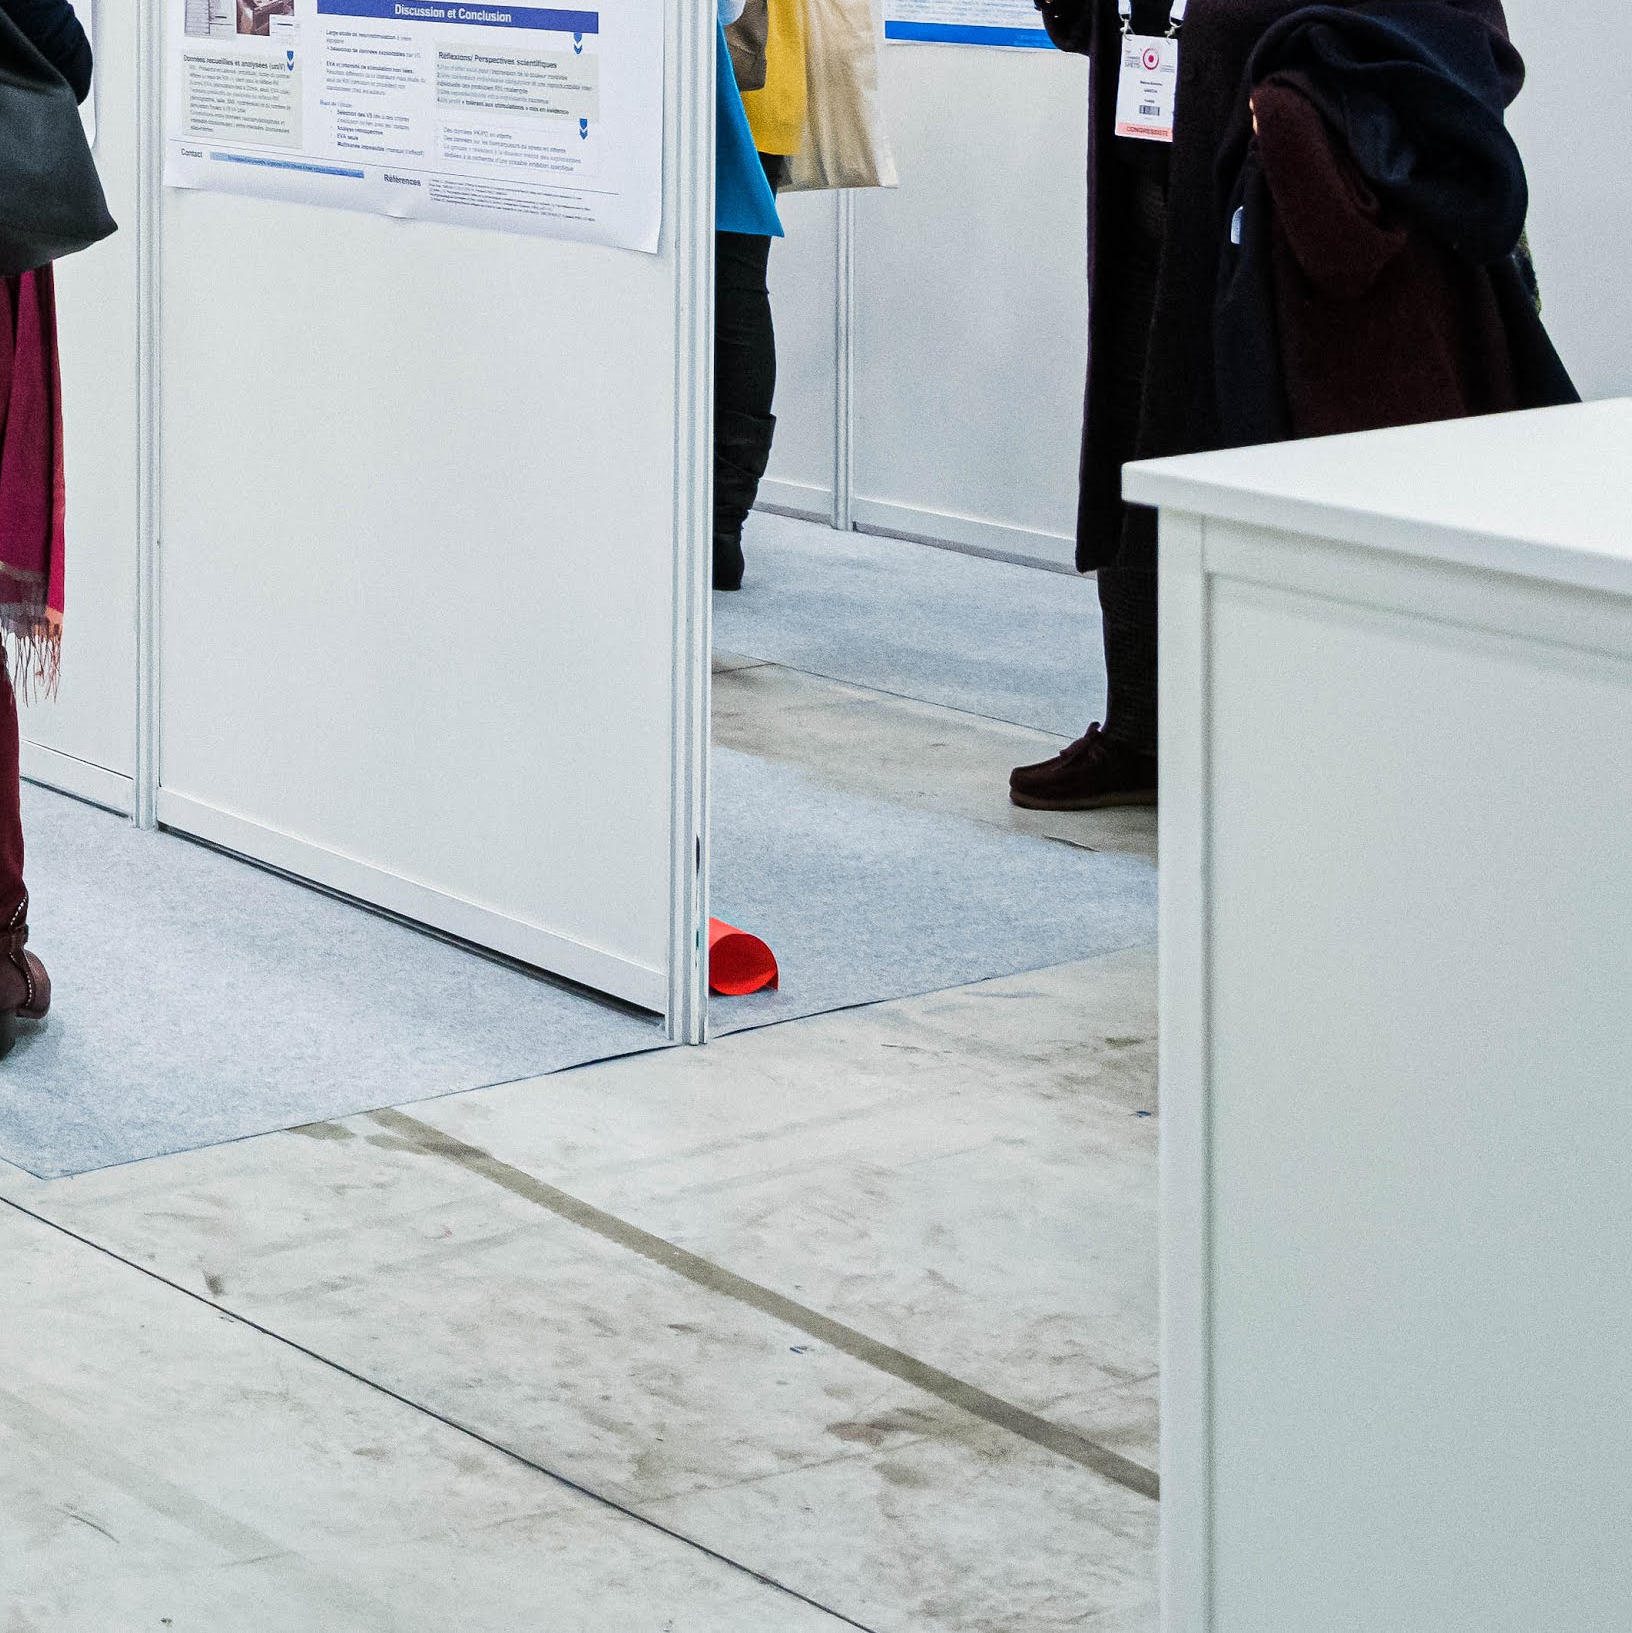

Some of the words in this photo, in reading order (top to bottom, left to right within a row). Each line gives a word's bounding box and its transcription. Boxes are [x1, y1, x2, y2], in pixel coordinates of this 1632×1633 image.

[395, 4, 444, 18] Discussion
[447, 9, 456, 19] et
[459, 8, 512, 22] Conclusion
[475, 55, 514, 66] Perspectives
[517, 59, 557, 69] scientifiques
[181, 148, 202, 158] Contact
